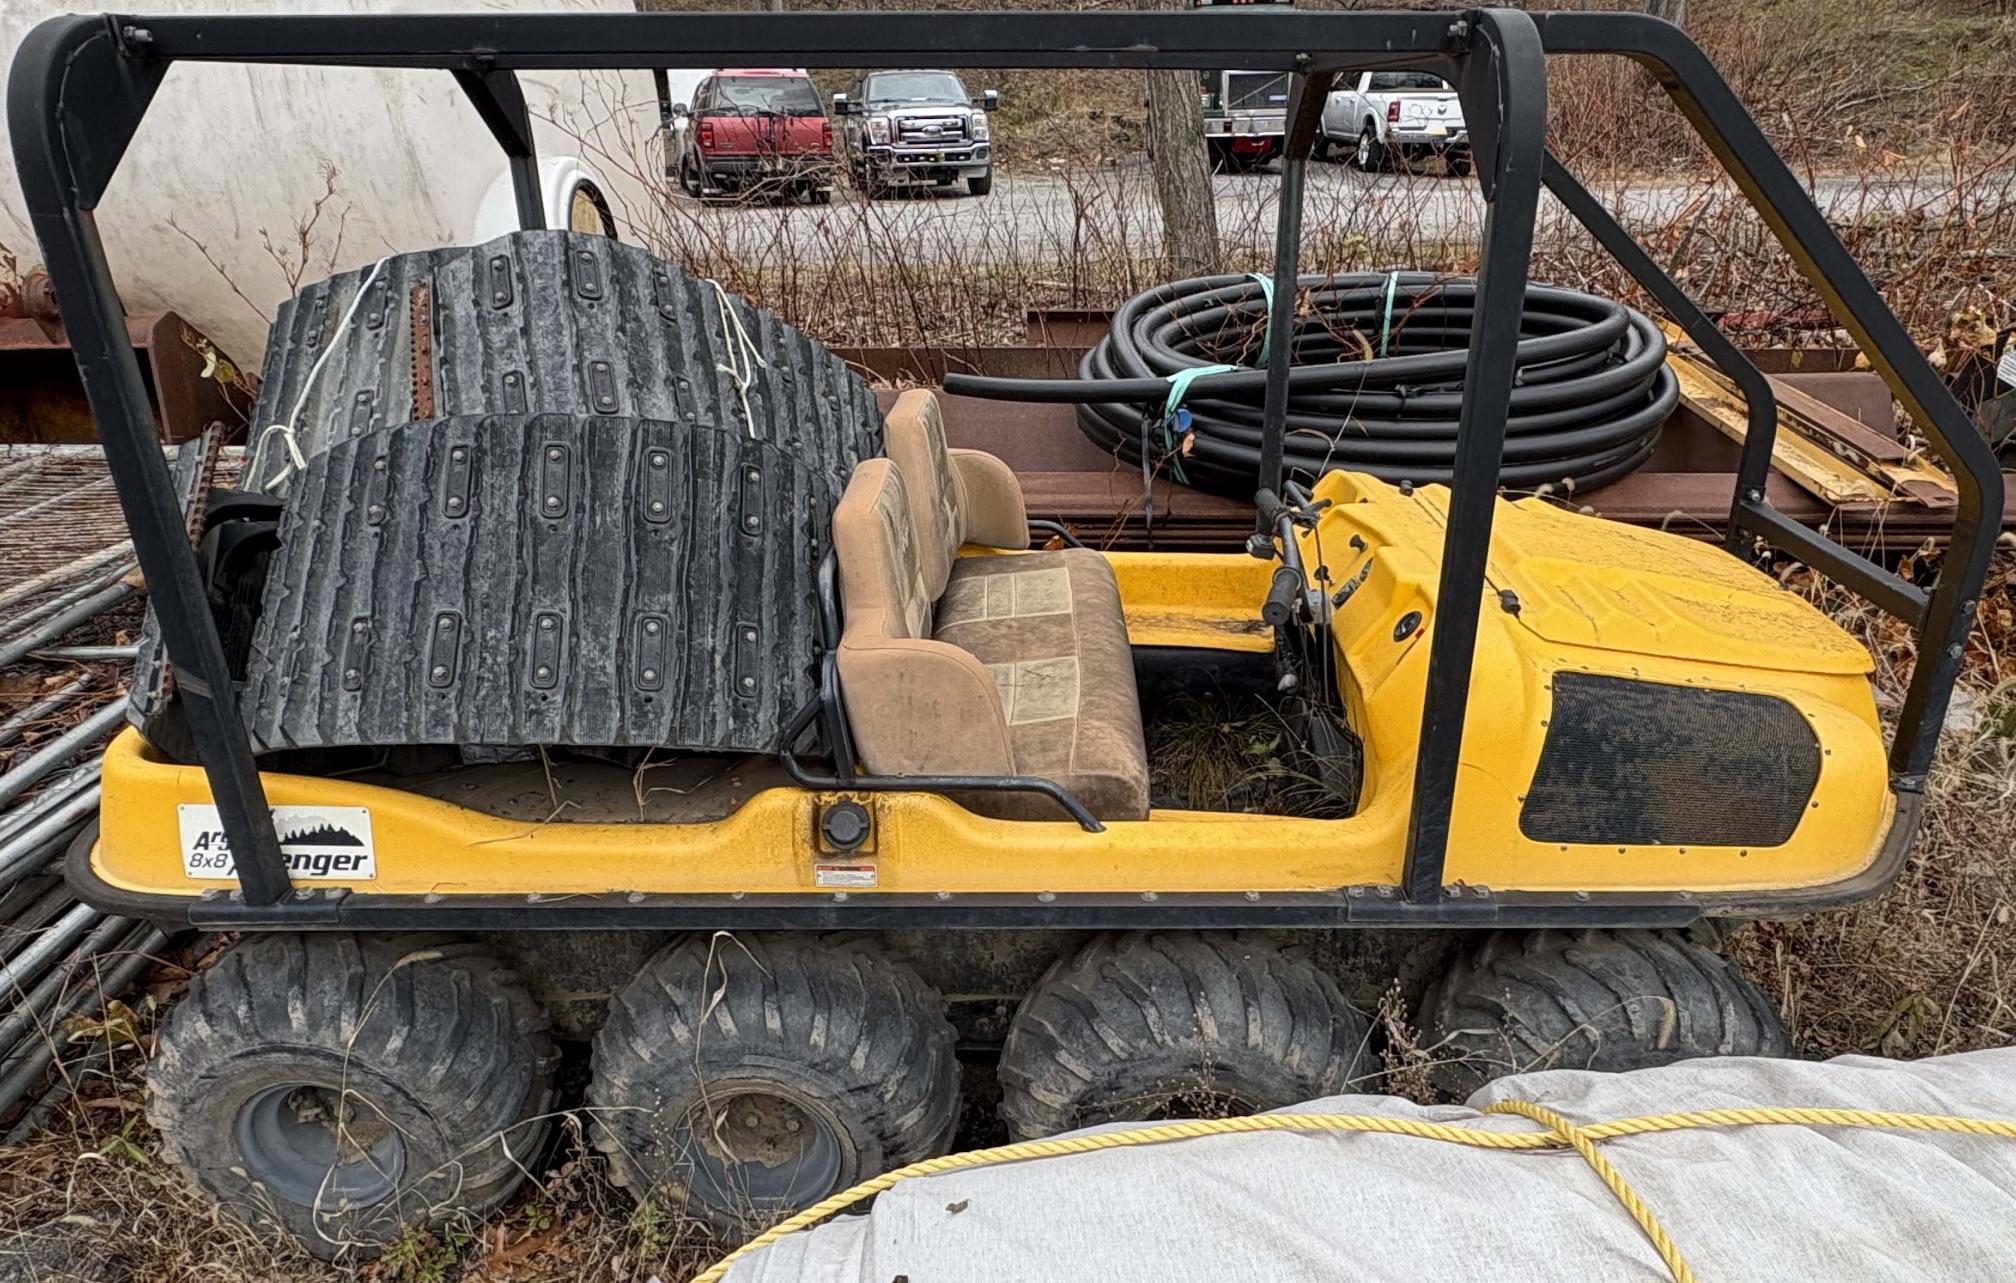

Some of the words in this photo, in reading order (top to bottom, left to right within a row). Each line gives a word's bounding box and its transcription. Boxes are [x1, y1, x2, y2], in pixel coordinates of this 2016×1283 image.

[192, 831, 231, 850] Arg
[189, 853, 228, 868] 8x8
[227, 854, 368, 876] enger
